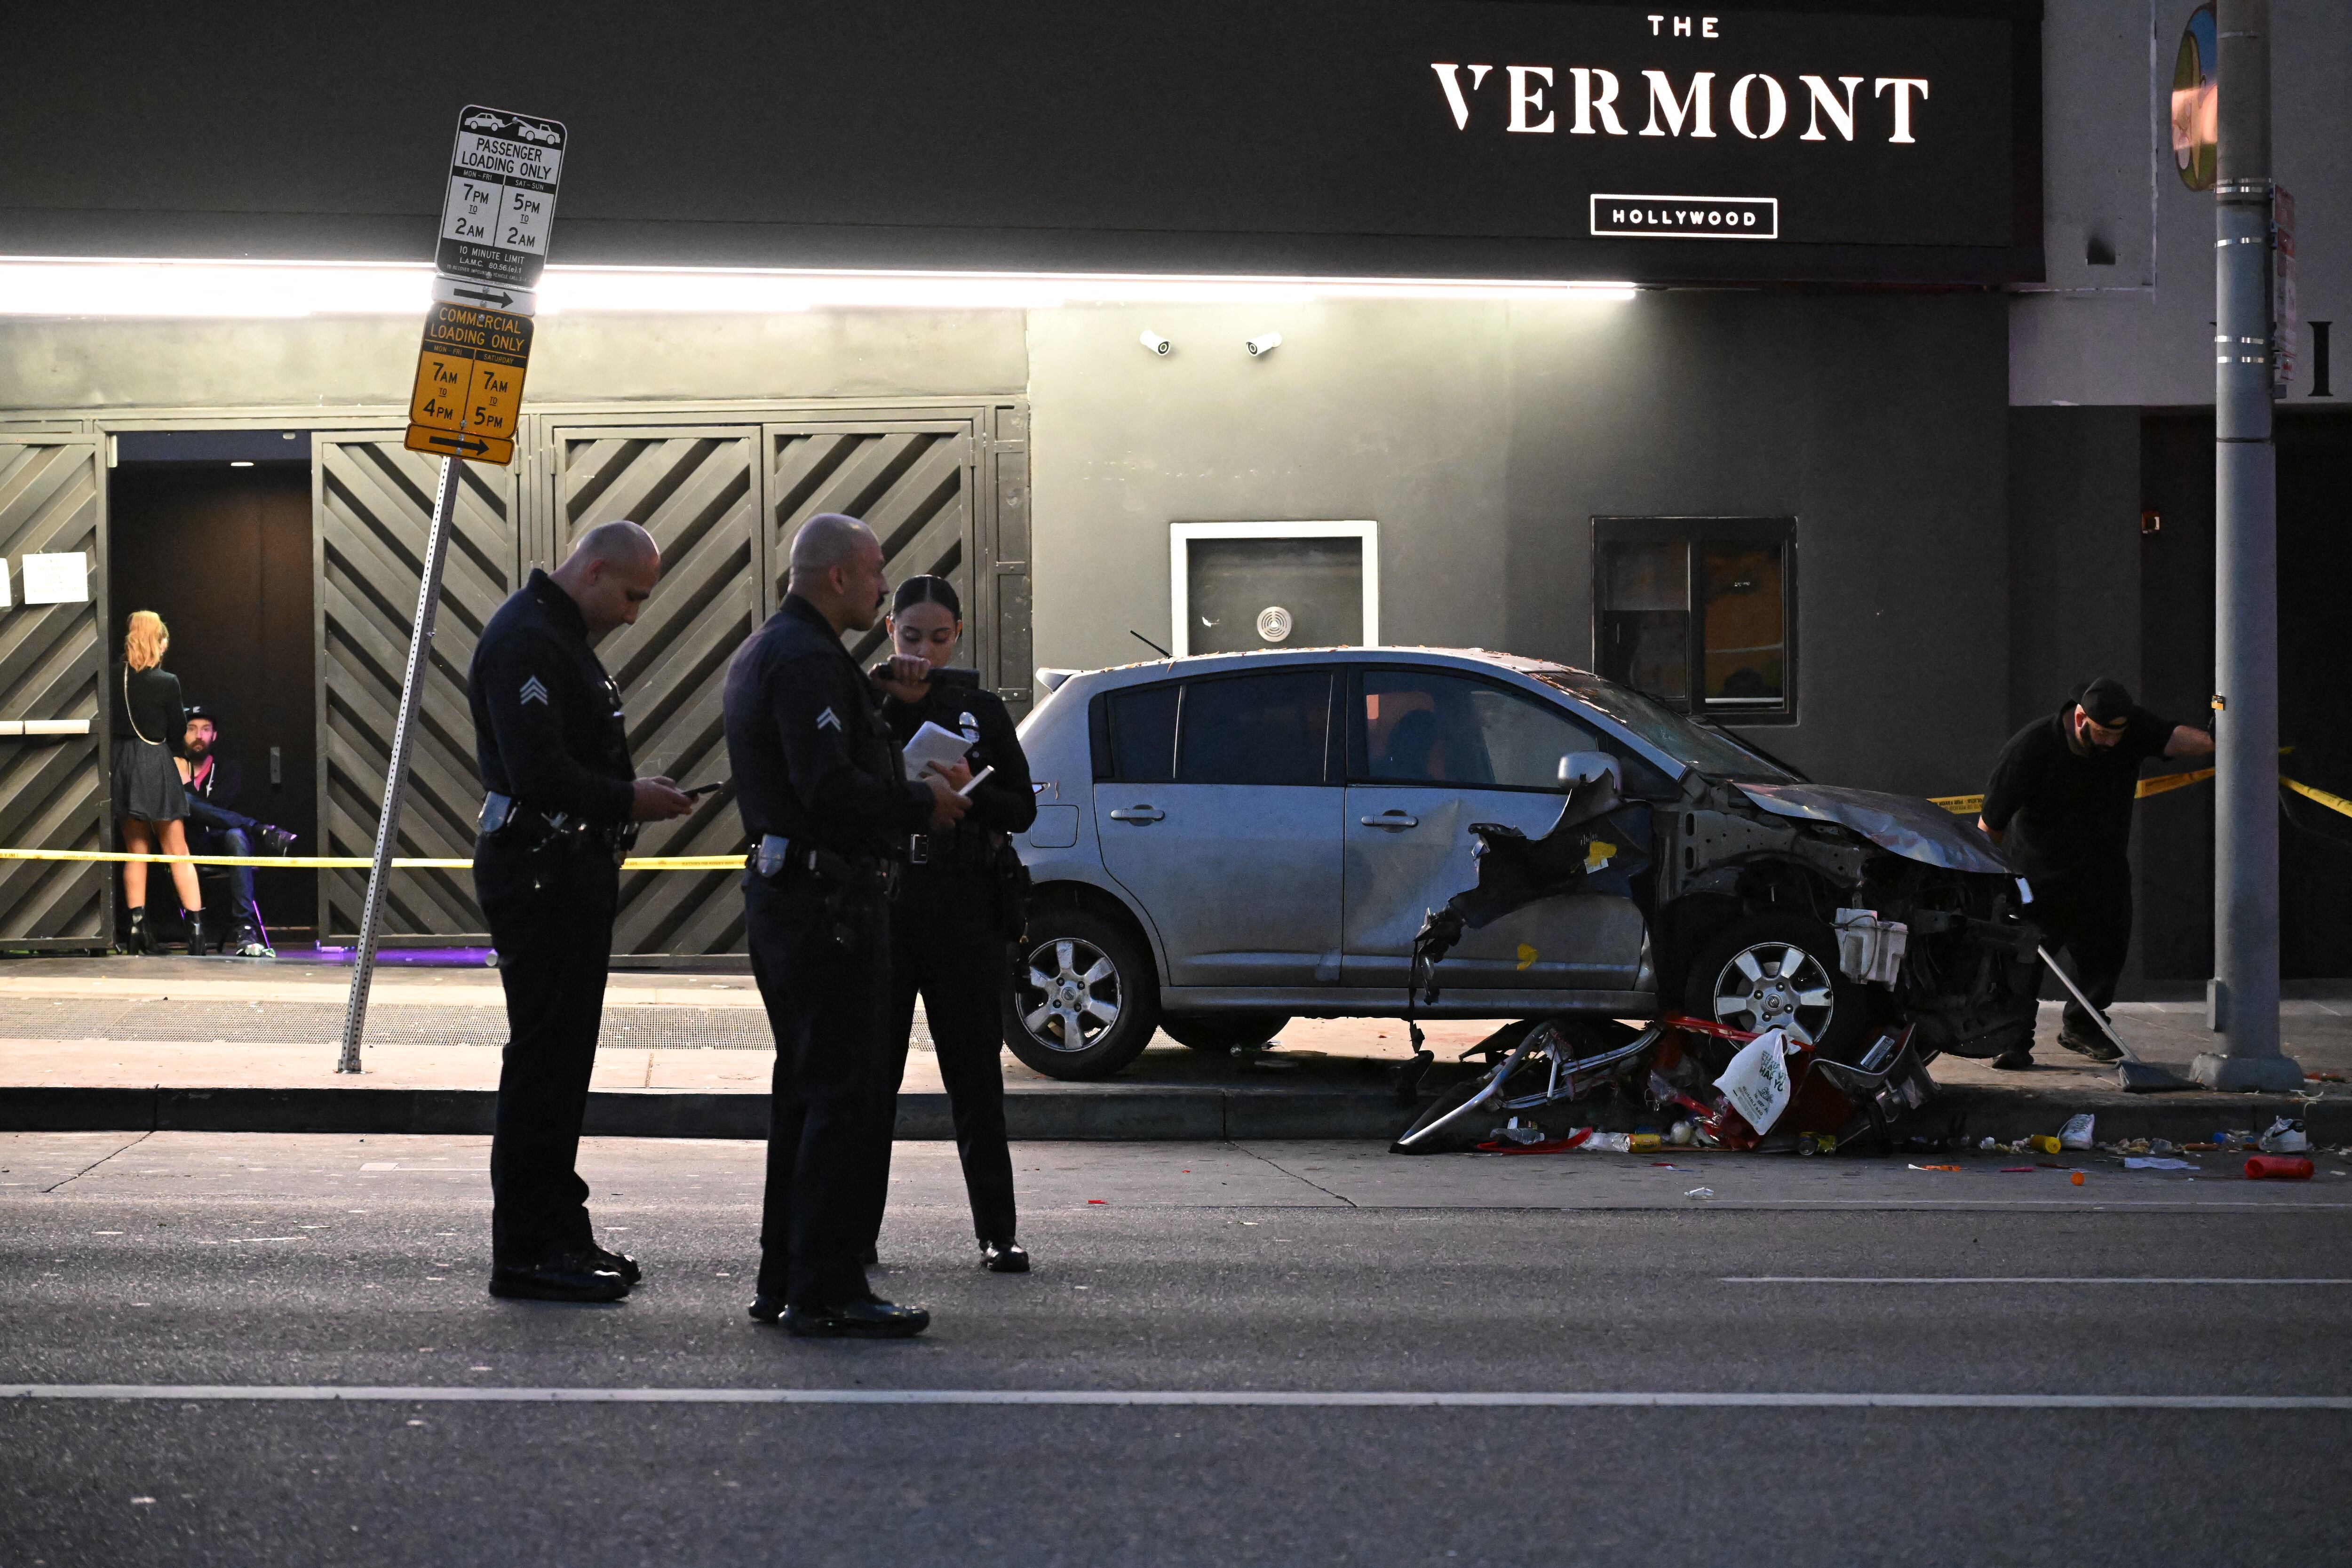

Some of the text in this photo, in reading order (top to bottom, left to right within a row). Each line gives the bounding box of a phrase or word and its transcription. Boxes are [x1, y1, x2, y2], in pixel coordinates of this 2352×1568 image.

[1647, 15, 1718, 38] THE
[1431, 63, 1928, 143] VERMONT
[476, 137, 542, 162] PASSENGER
[461, 151, 552, 180] LOADING ONLY
[463, 183, 489, 204] 7PM
[513, 193, 540, 214] 5PM
[455, 217, 484, 238] 2AM
[1613, 209, 1756, 226] HOLLYWOOD
[507, 227, 535, 247] 2AM
[460, 245, 524, 264] 10 MINUTE LIMIT
[460, 257, 484, 267] L.A.M.C.
[430, 323, 525, 351] LOADING ONLY
[484, 354, 514, 365] SATURDAY
[433, 361, 458, 384] 7AM
[484, 371, 508, 393] 7AM
[423, 398, 453, 420] 4PM
[474, 406, 503, 429] 5PM
